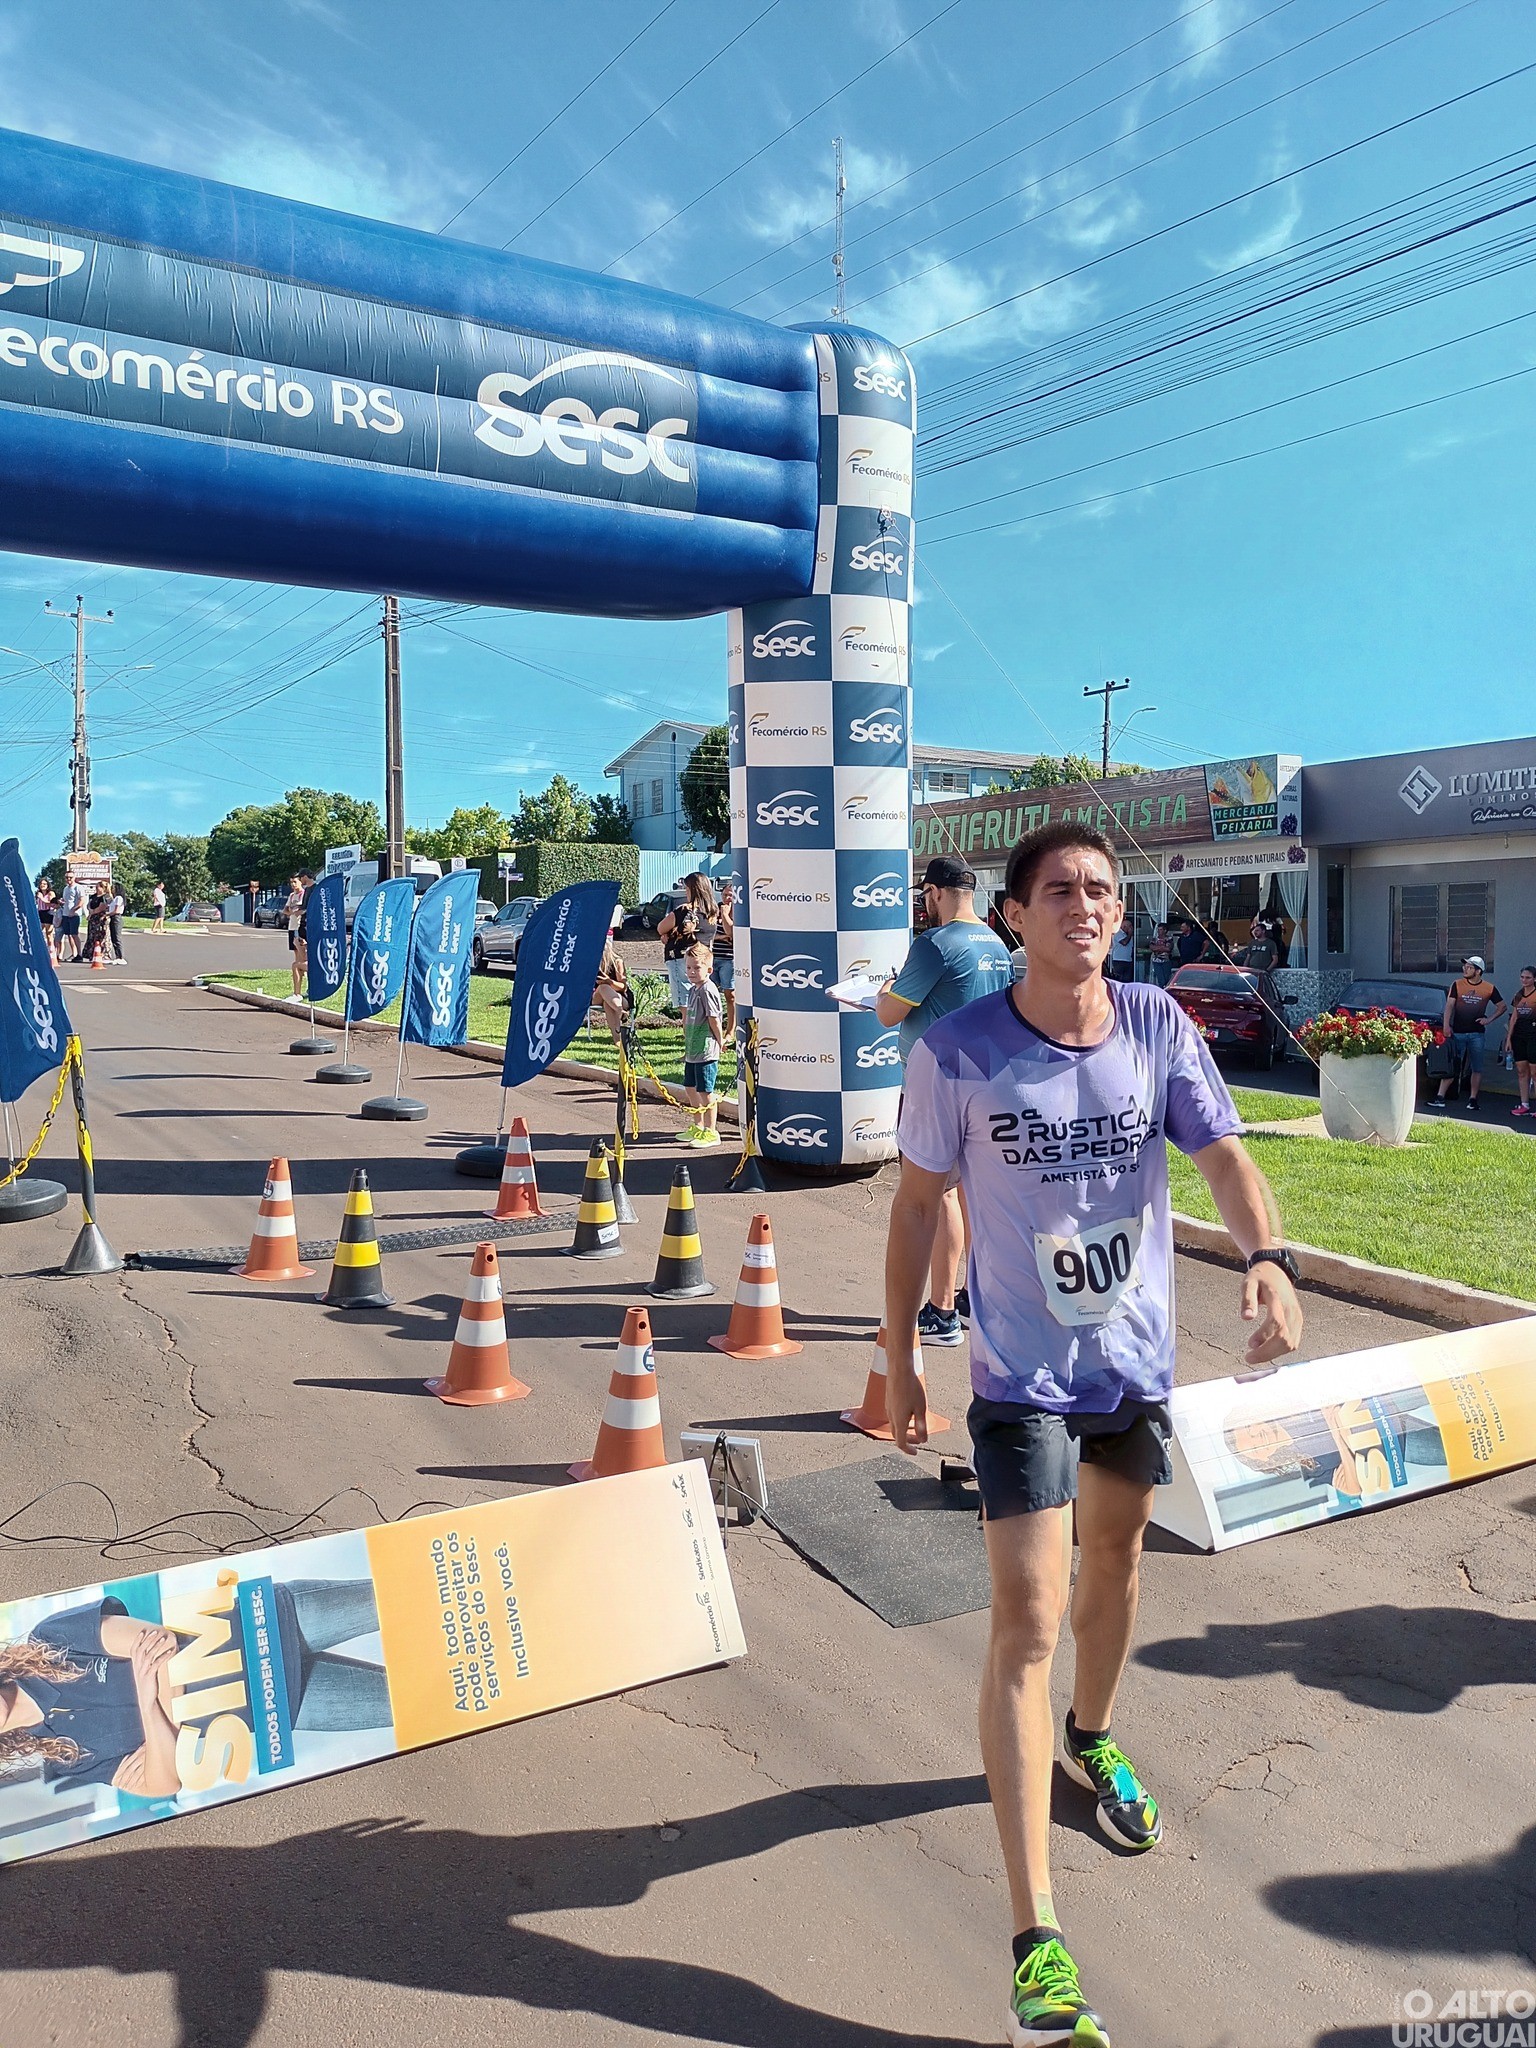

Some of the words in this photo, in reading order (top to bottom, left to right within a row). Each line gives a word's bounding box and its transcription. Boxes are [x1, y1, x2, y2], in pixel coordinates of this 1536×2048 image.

[0, 325, 315, 419] ecomércio
[332, 379, 404, 435] RS
[853, 363, 907, 402] Sesc
[474, 362, 691, 484] Sesc
[852, 463, 903, 482] Fecomércio
[902, 472, 911, 486] RS
[849, 540, 903, 576] Sesc
[752, 627, 816, 658] Sesc
[845, 640, 897, 655] Fecomércio
[898, 645, 907, 657] RS
[752, 725, 809, 737] Fecomércio
[811, 726, 827, 736] RS
[849, 713, 903, 744] Sesc
[756, 797, 820, 827] Sesc
[848, 809, 899, 821] Fecomércio
[912, 803, 1051, 856] ORTIFRUTI
[1062, 794, 1187, 831] AMETISTA
[1214, 803, 1275, 819] MERCEARIA
[1221, 819, 1273, 833] PEIXARIA
[1186, 857, 1223, 868] ARTESANATO
[1225, 857, 1228, 866] E
[1229, 854, 1254, 866] PEDRAS
[1254, 852, 1286, 864] NATURAIS
[756, 891, 812, 903] Fecomércio
[815, 892, 831, 903] RS
[851, 879, 904, 909] Sesc
[372, 891, 386, 942] Fecomércio
[438, 895, 452, 954] Fecomércio
[544, 898, 571, 971] Fecomércio
[322, 938, 339, 985] Sesc
[559, 933, 577, 973] Senac
[364, 949, 389, 1007] Sesc
[760, 959, 824, 989] Sesc
[22, 966, 58, 1053] Sesc
[429, 962, 455, 1028] Sesc
[526, 983, 564, 1064] Sesc
[761, 1051, 817, 1064] Fecomércio
[819, 1053, 836, 1064] RS
[766, 1116, 829, 1148] Sesc
[1002, 1145, 1062, 1165] DAS
[1071, 1121, 1159, 1161] PEDRS
[1028, 1108, 1149, 1143] RÚSTICA
[1041, 1168, 1107, 1184] AMETISTA
[1110, 1164, 1127, 1177] DO
[1052, 1231, 1132, 1296] 900
[919, 1323, 939, 1334] FILA
[1467, 1427, 1481, 1460] Aqui,
[1476, 1429, 1489, 1461] pode
[1390, 1451, 1402, 1482] TODOS
[447, 1532, 459, 1553] os
[464, 1537, 480, 1585] Sesc.
[430, 1539, 452, 1605] mundo
[494, 1542, 514, 1591] você.
[251, 1585, 266, 1626] SESC.
[451, 1559, 478, 1655] aproveitar
[471, 1590, 486, 1615] do
[256, 1626, 270, 1655] SER
[441, 1610, 460, 1657] todo
[506, 1596, 530, 1678] Inclusive
[706, 1605, 722, 1653] Fecomércio
[477, 1620, 501, 1699] serviços
[260, 1657, 277, 1710] PODEM
[448, 1660, 470, 1711] Aqui,
[466, 1661, 489, 1712] pode
[267, 1711, 283, 1765] TODOS
